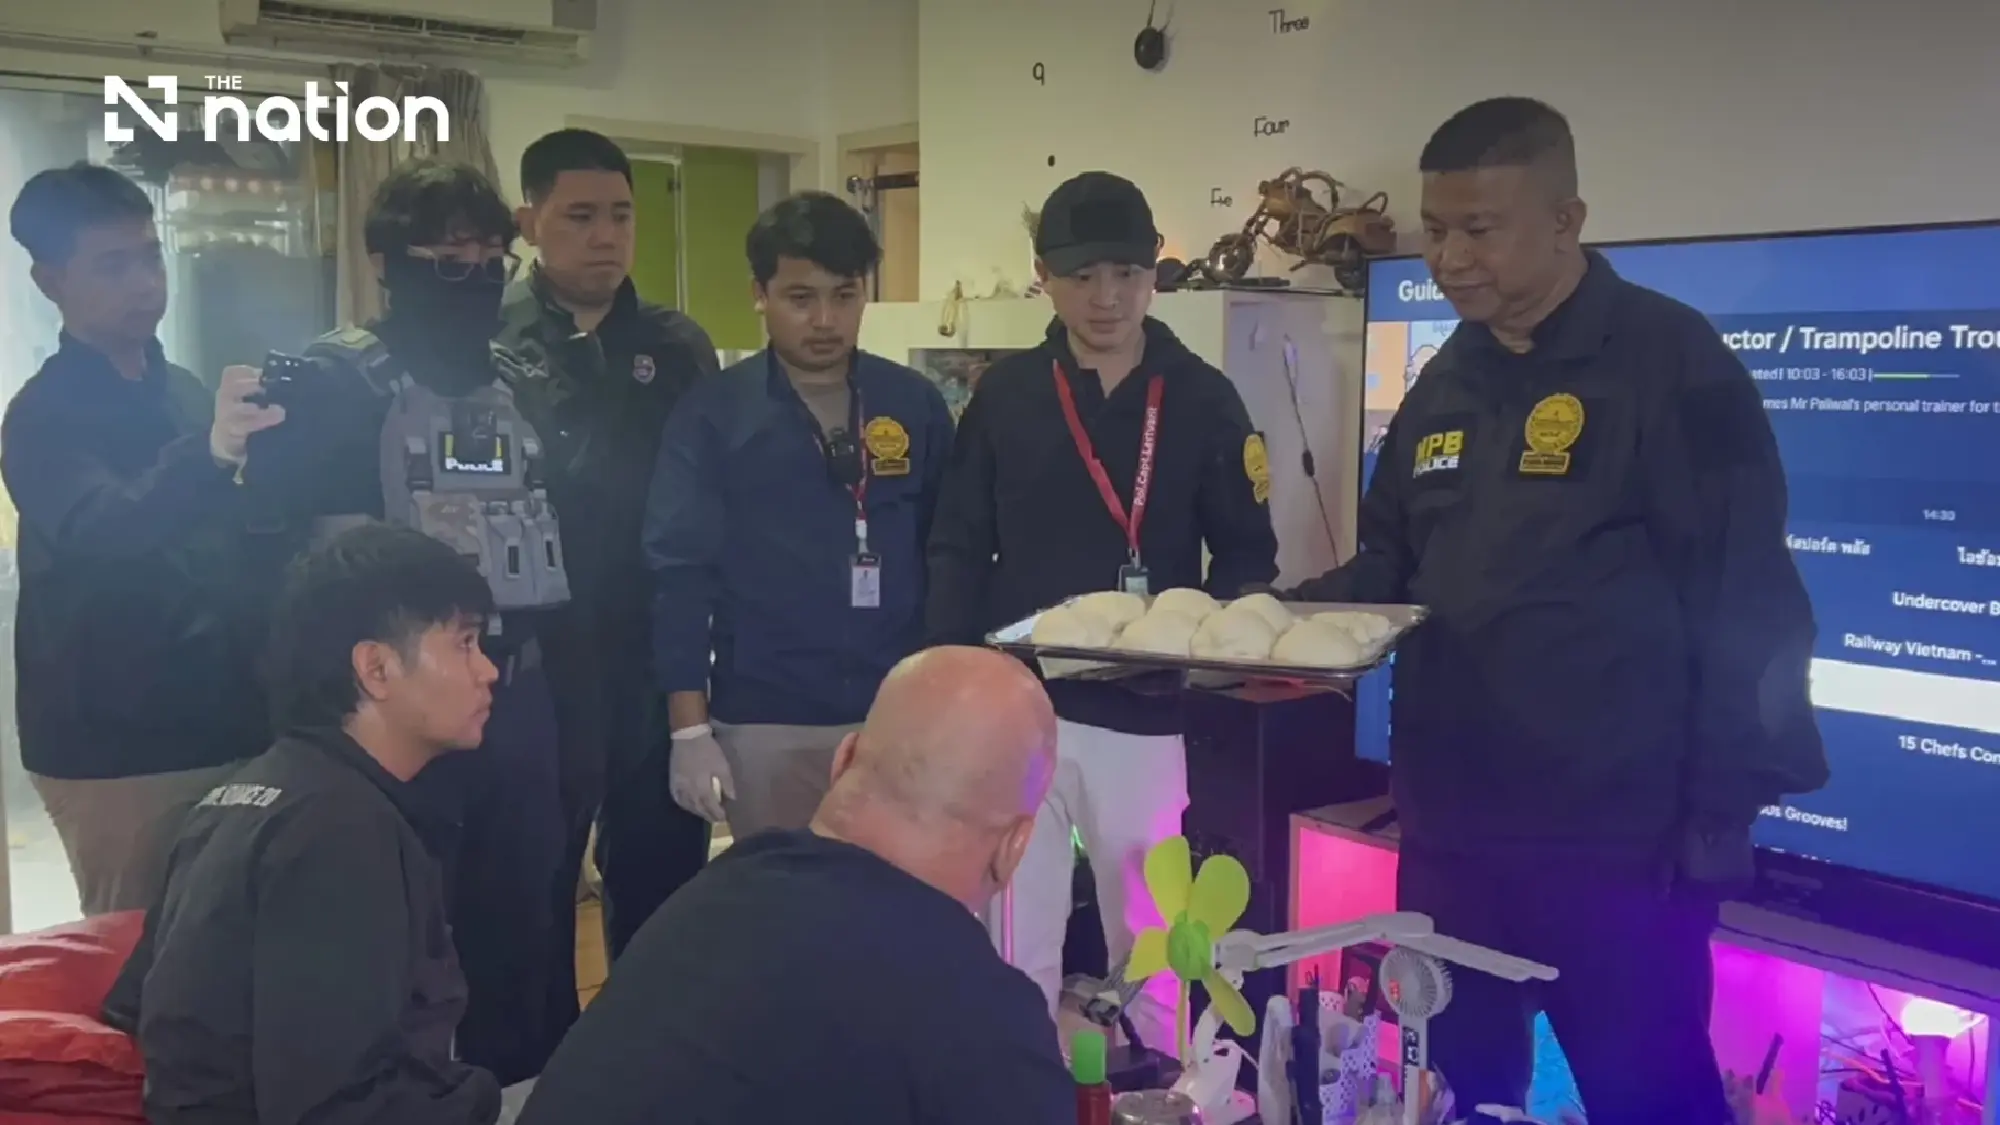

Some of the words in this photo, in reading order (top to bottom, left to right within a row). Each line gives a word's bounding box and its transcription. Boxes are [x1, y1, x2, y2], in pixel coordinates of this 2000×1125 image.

[1268, 8, 1310, 34] Three
[1779, 325, 1796, 353] /
[1799, 324, 1942, 355] Trampoline
[1786, 367, 1820, 381] 10:03
[1790, 397, 1807, 410] Mr
[1864, 398, 1920, 414] personal
[1922, 399, 1968, 412] trainer
[1969, 399, 1990, 413] for
[1922, 509, 1956, 521] 14:30
[1892, 591, 1986, 614] Undercover
[1844, 633, 1902, 657] Railway
[1906, 641, 1972, 661] Vietnam
[1898, 735, 1916, 750] 15
[1920, 737, 1967, 759] Chefs
[1785, 805, 1848, 831] Grooves!
